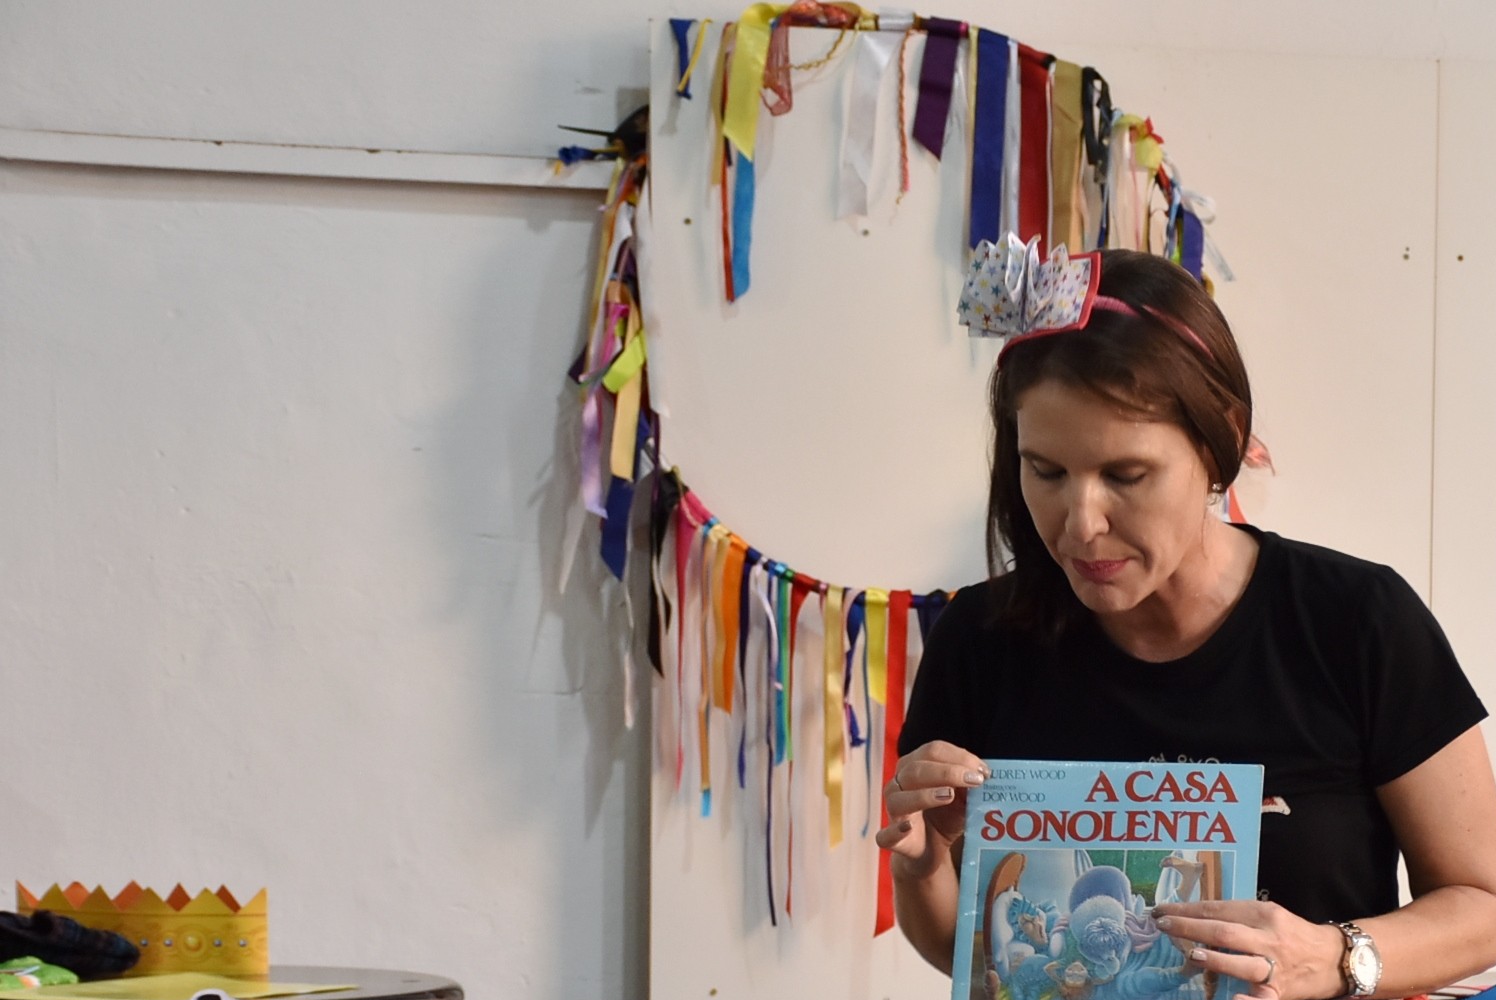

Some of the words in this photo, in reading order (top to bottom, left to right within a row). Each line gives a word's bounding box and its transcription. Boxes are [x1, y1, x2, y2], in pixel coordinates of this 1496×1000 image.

[989, 768, 1027, 780] UDREY
[1030, 768, 1066, 780] WOOD
[1085, 770, 1119, 803] A
[1124, 770, 1239, 804] CASA
[980, 808, 1238, 844] SONOLENTA
